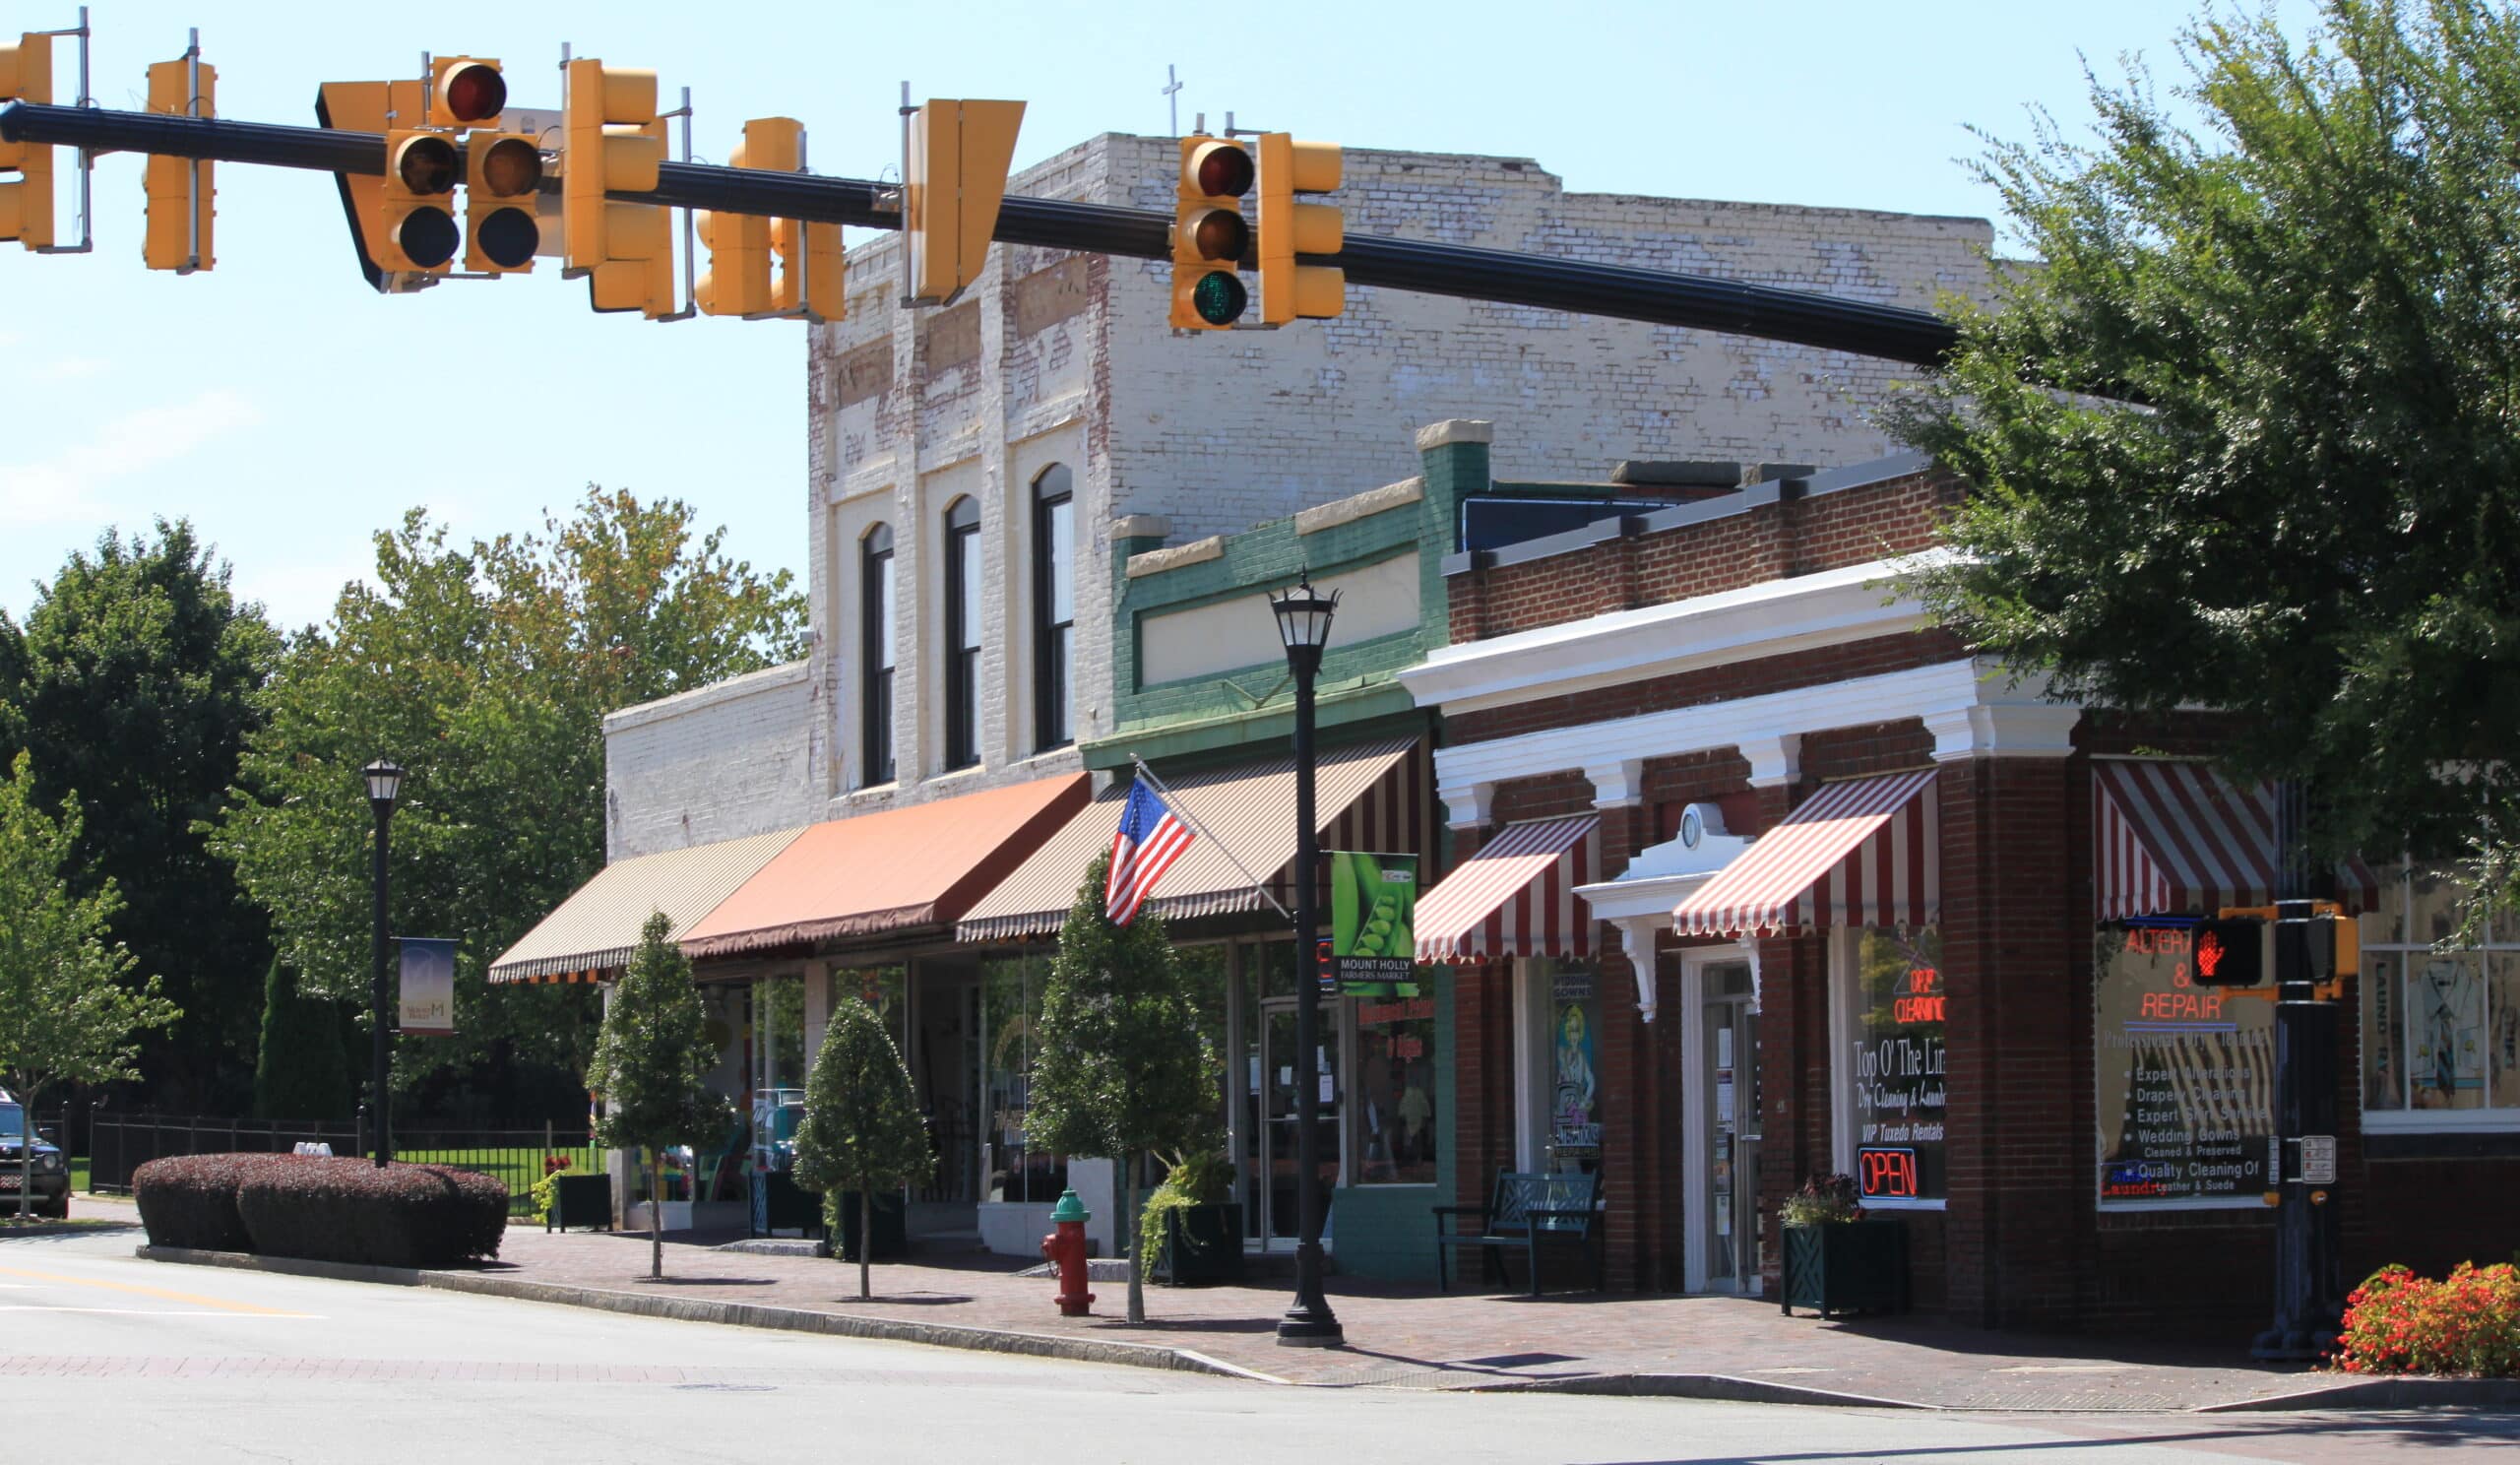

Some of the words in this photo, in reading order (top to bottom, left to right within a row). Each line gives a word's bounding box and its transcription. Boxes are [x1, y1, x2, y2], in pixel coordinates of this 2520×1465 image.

[1340, 959, 1376, 970] MOUNT
[1379, 960, 1411, 971] HOLLY
[1340, 970, 1376, 979] FARMERS
[1377, 971, 1411, 980] MARKET
[2173, 962, 2191, 988] &
[2141, 992, 2222, 1019] REPAIR
[1854, 1041, 1877, 1087] Top
[1880, 1039, 1895, 1077] O'
[1897, 1037, 1922, 1076] The
[2136, 1067, 2176, 1083] Expert
[2184, 1065, 2251, 1080] Alterations
[1857, 1082, 1873, 1115] Dry
[1874, 1082, 1908, 1115] Cleaning
[1910, 1086, 1918, 1108] &
[2137, 1088, 2186, 1104] Drapery
[2192, 1086, 2246, 1102] Cleaning
[2137, 1108, 2179, 1124] Expert
[1862, 1123, 1877, 1142] VIP
[1879, 1123, 1910, 1142] Tuxedo
[1912, 1121, 1944, 1141] Rentals
[2138, 1129, 2192, 1146] Wedding
[2198, 1127, 2240, 1142] Gowns
[2144, 1146, 2182, 1158] Cleaned
[2186, 1146, 2192, 1157] &
[2196, 1145, 2242, 1157] Preserved
[1861, 1152, 1918, 1196] OPEN
[2137, 1164, 2182, 1180] Quality
[2188, 1162, 2241, 1178] Cleaning
[2244, 1161, 2259, 1175] Of
[2156, 1179, 2190, 1191] Leather
[2195, 1179, 2201, 1190] &
[2205, 1179, 2236, 1190] Suede
